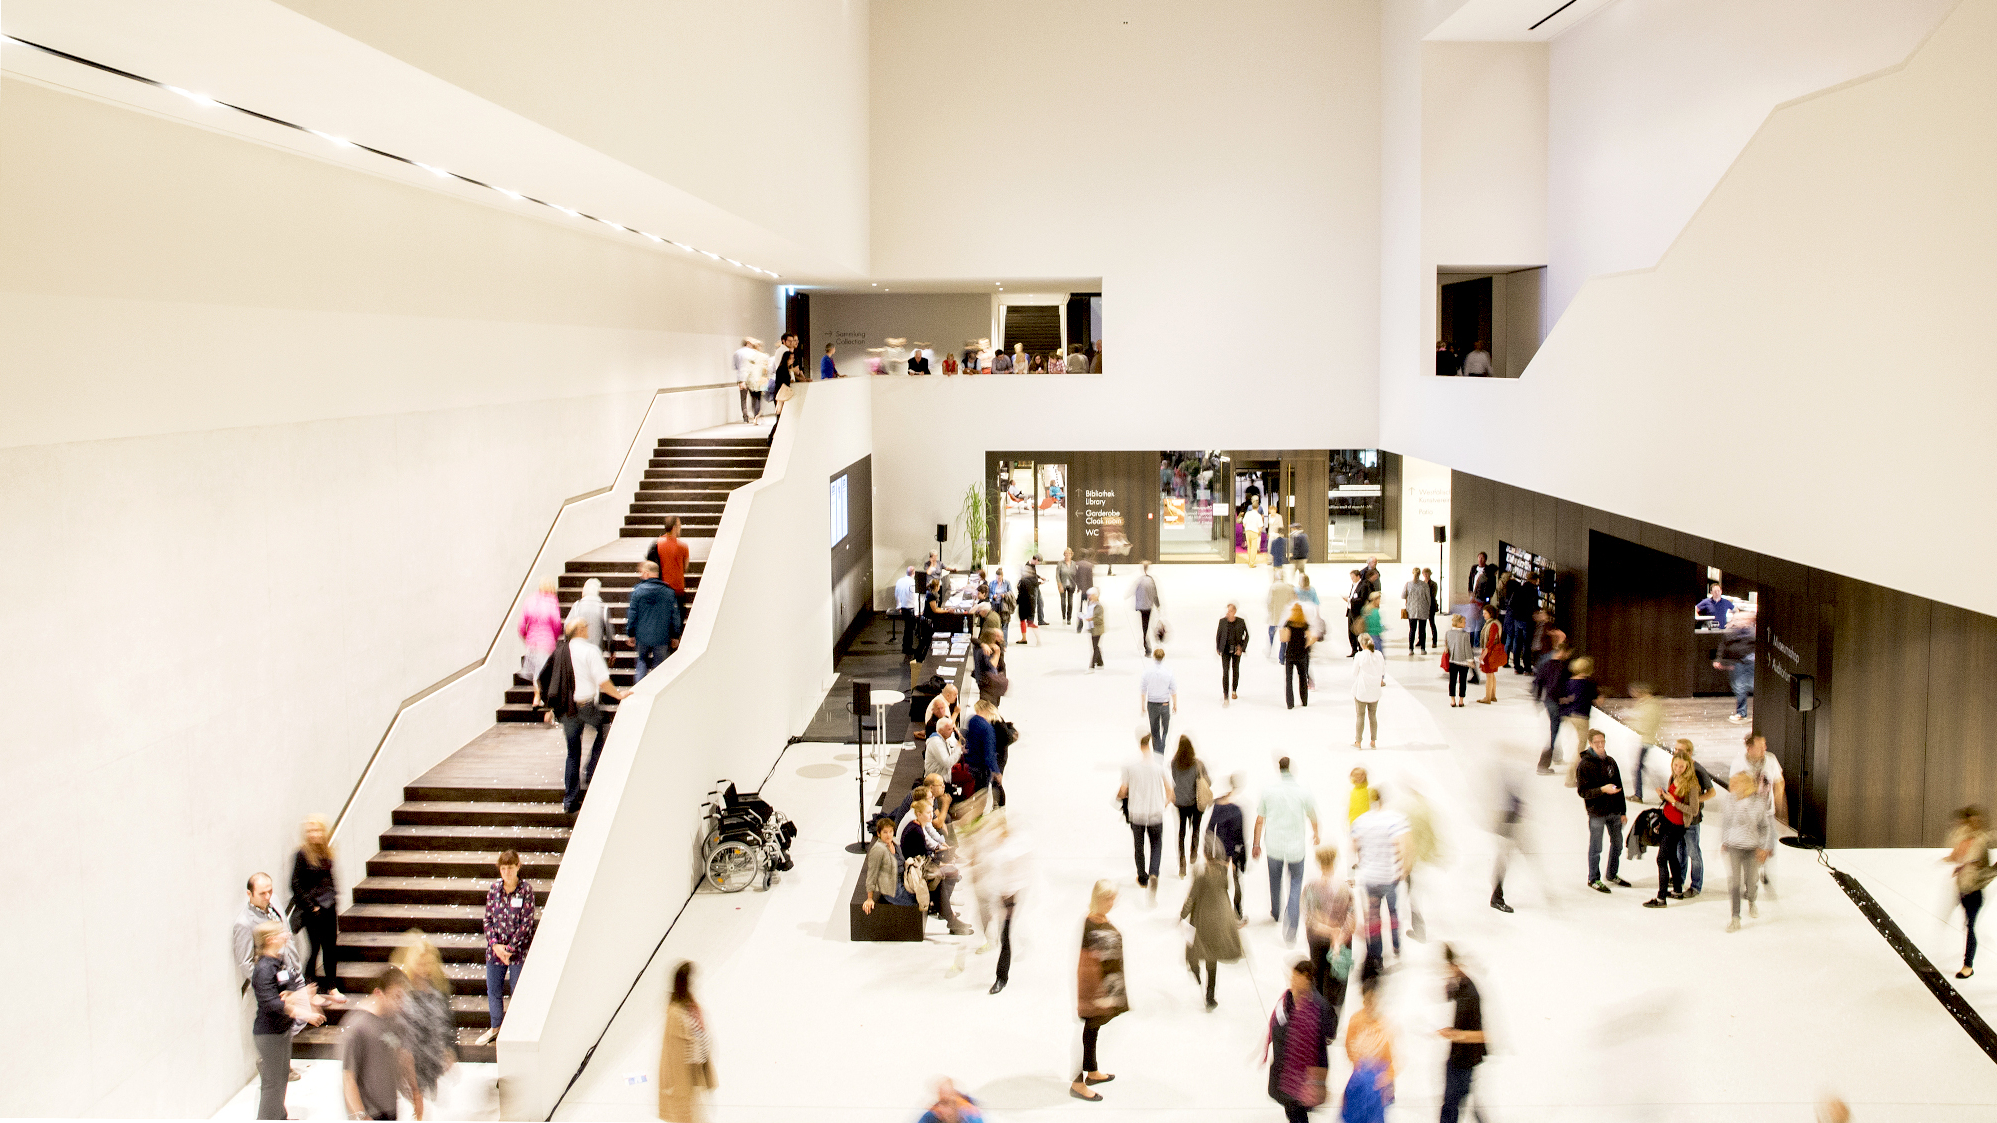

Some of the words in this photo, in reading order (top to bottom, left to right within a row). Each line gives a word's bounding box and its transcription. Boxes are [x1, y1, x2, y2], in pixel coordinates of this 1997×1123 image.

[1085, 489, 1115, 498] Bibliothek
[1085, 497, 1106, 506] Library
[1085, 509, 1120, 517] Garderobe
[1085, 517, 1104, 525] Cloak
[1085, 528, 1100, 536] WC
